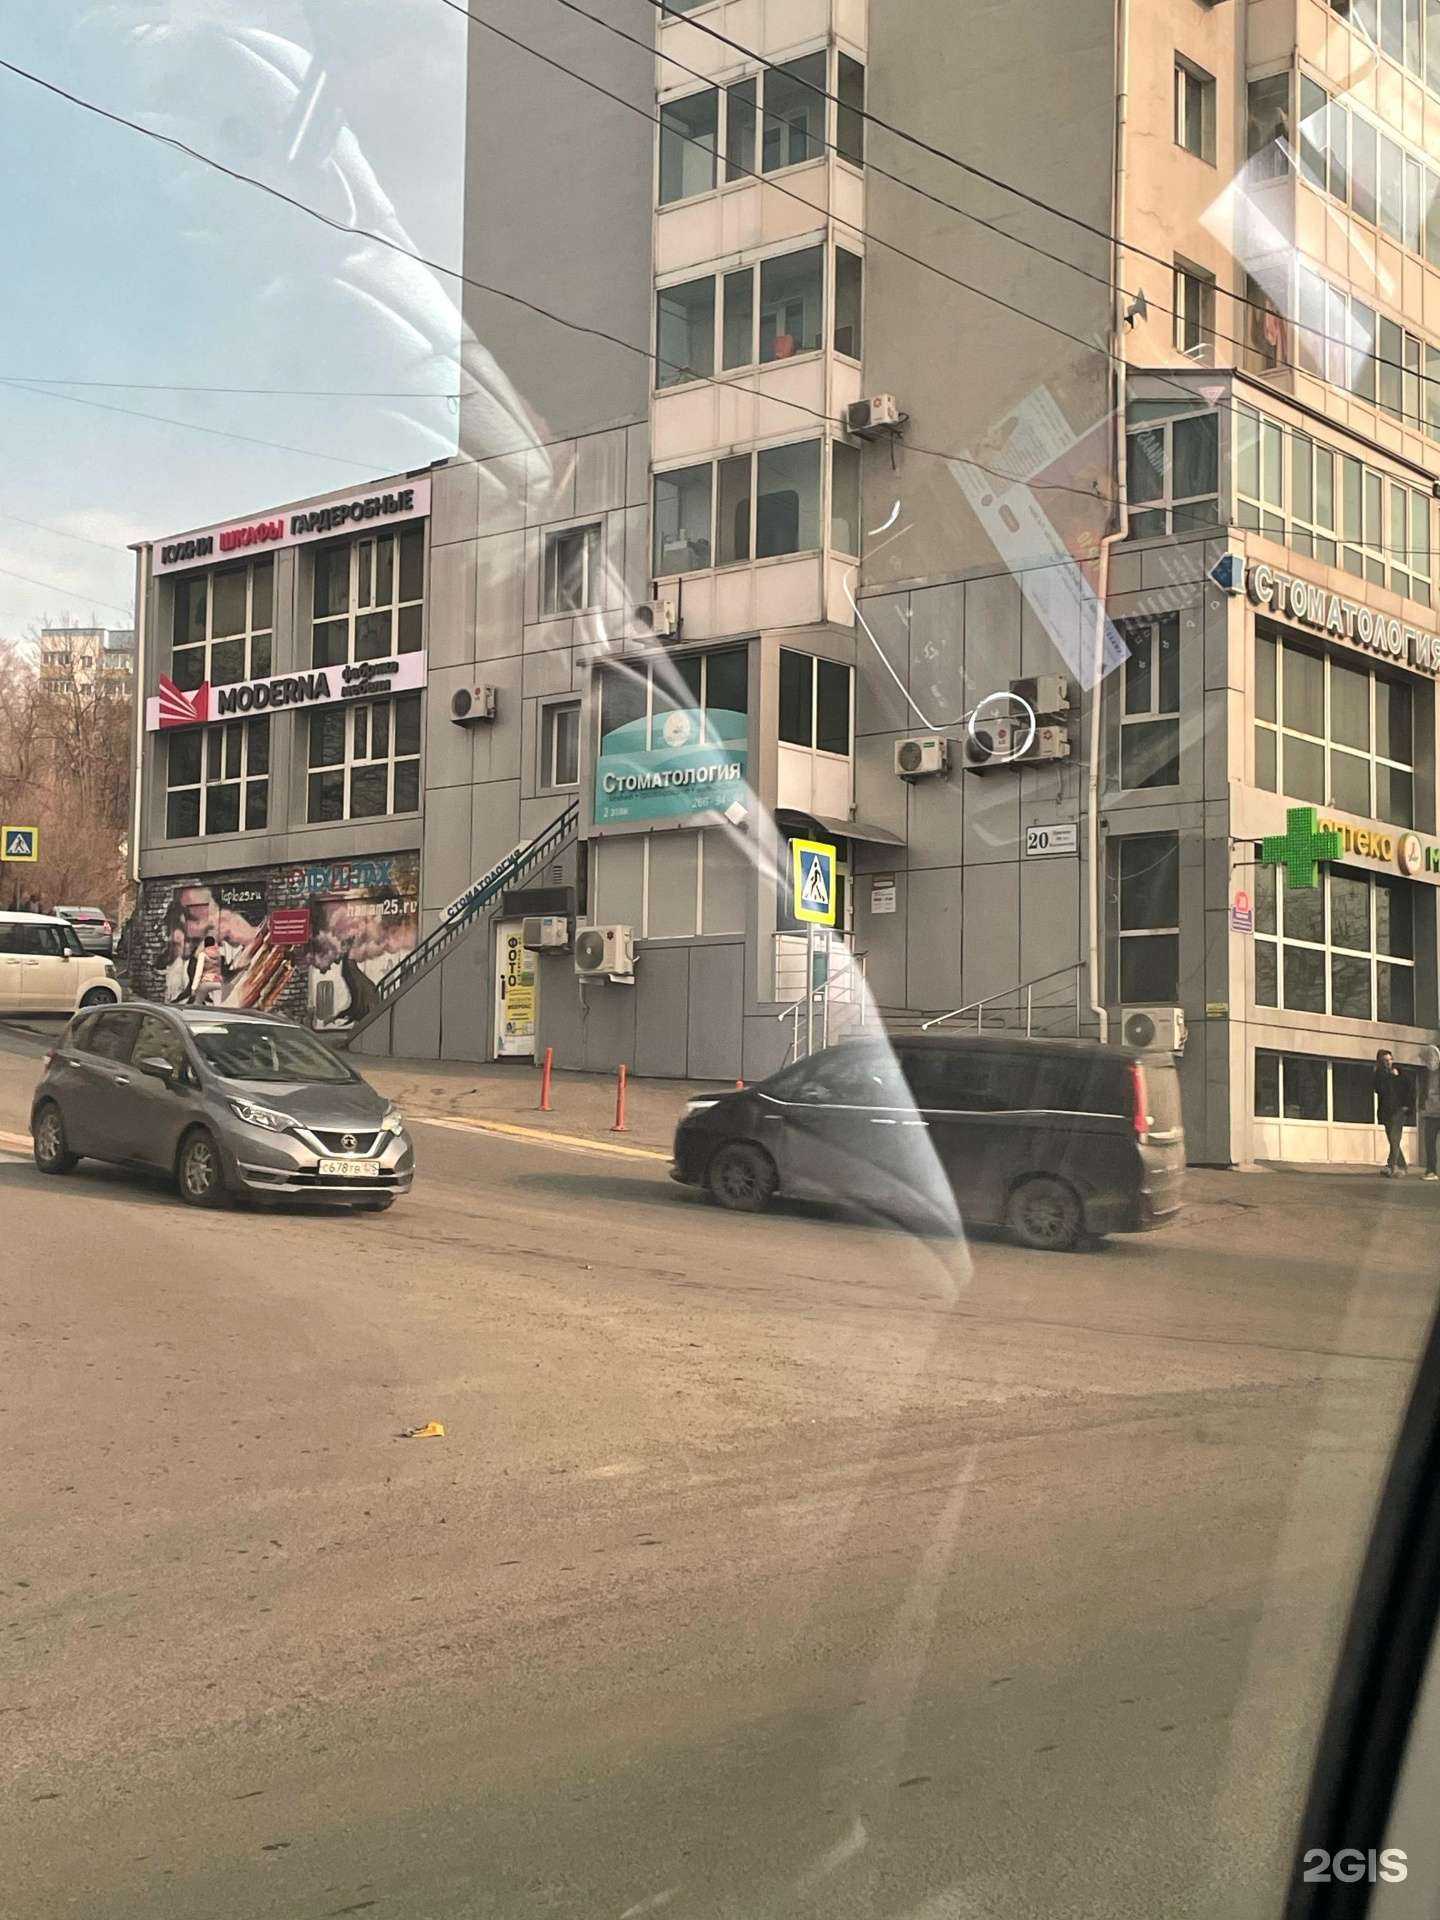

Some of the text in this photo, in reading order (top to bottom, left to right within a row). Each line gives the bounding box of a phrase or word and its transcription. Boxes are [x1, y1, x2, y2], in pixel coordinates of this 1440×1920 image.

[161, 488, 415, 566] КУХНИ ШКАФЫ ГАРДЕРОБНЫЕ
[1248, 563, 1440, 674] СТОМАТОЛОГИЯ
[217, 671, 331, 715] MODERNA
[1028, 831, 1049, 849] 20
[507, 936, 518, 987] ФОТО
